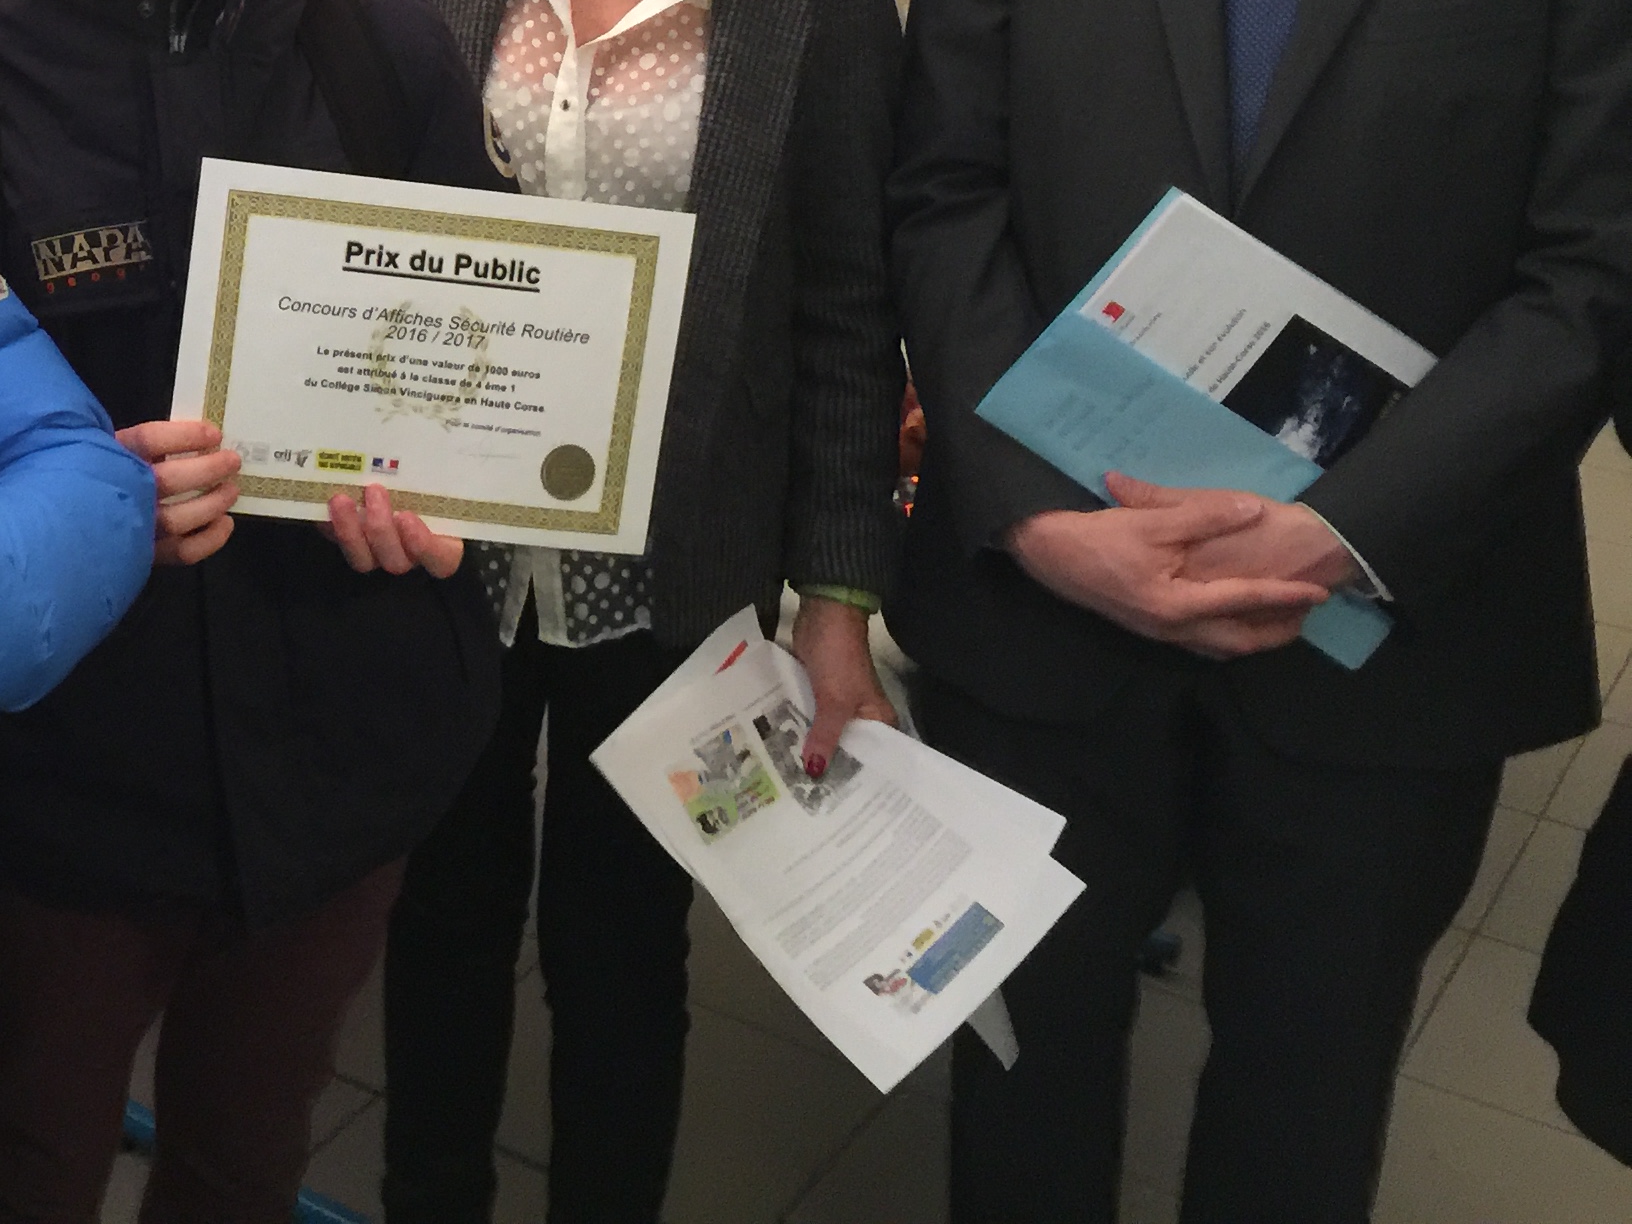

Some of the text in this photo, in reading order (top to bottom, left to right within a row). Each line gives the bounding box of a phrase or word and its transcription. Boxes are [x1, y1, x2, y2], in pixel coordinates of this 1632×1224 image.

[345, 240, 541, 285] Prix du Public
[278, 295, 590, 345] Concours d'Affiches Sécurité Routière
[385, 325, 486, 350] 2016 / 2017
[317, 346, 541, 380] Le présent prix d'une valeur de 1000 euros
[337, 365, 354, 375] est
[357, 367, 397, 380] attribué
[410, 372, 419, 382] la
[422, 374, 457, 386] classe
[459, 378, 473, 389] de
[475, 380, 482, 390] 4
[304, 377, 318, 388] du
[320, 379, 360, 393] Collège
[464, 395, 478, 406] en
[480, 397, 511, 410] Haute
[513, 401, 545, 413] Corse
